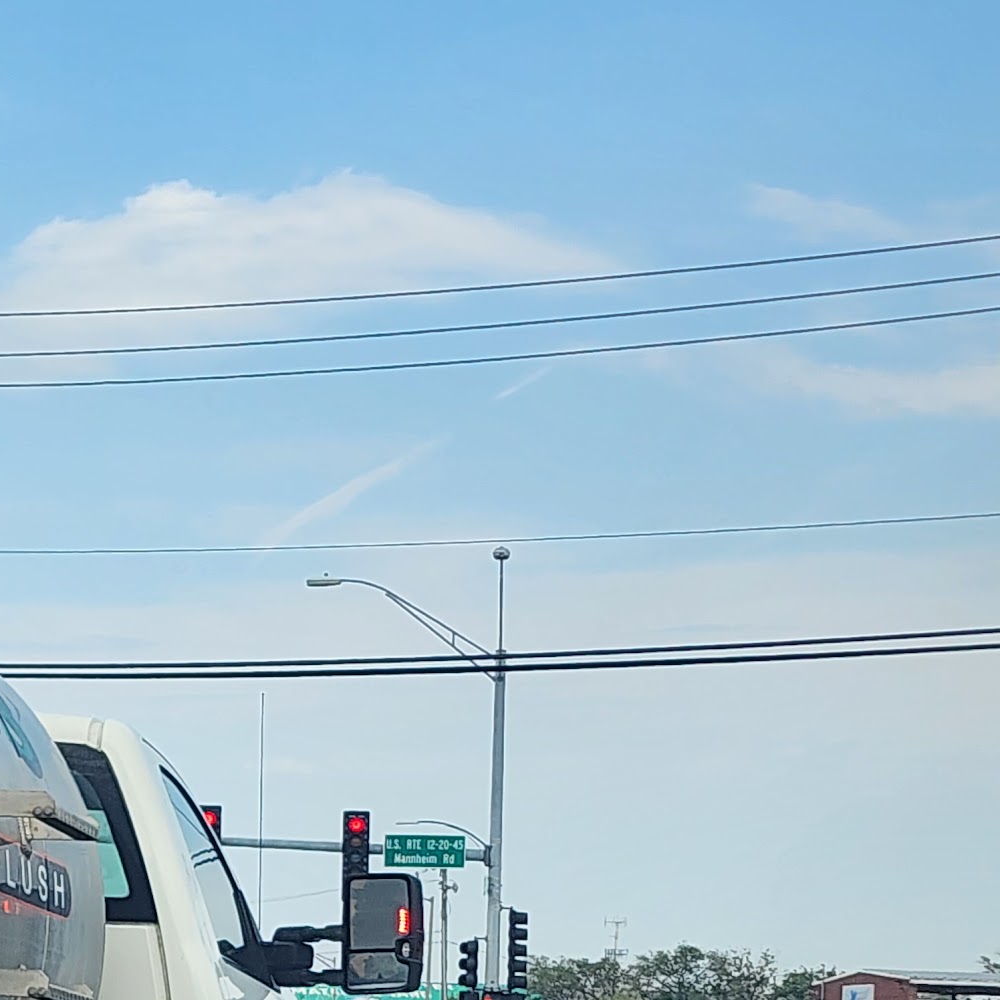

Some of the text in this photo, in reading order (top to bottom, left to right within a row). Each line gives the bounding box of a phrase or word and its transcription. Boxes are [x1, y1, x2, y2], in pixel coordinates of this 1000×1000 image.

[386, 838, 402, 850] U.S.
[426, 839, 464, 850] 12-20-45
[393, 852, 456, 864] Mannheim Rd
